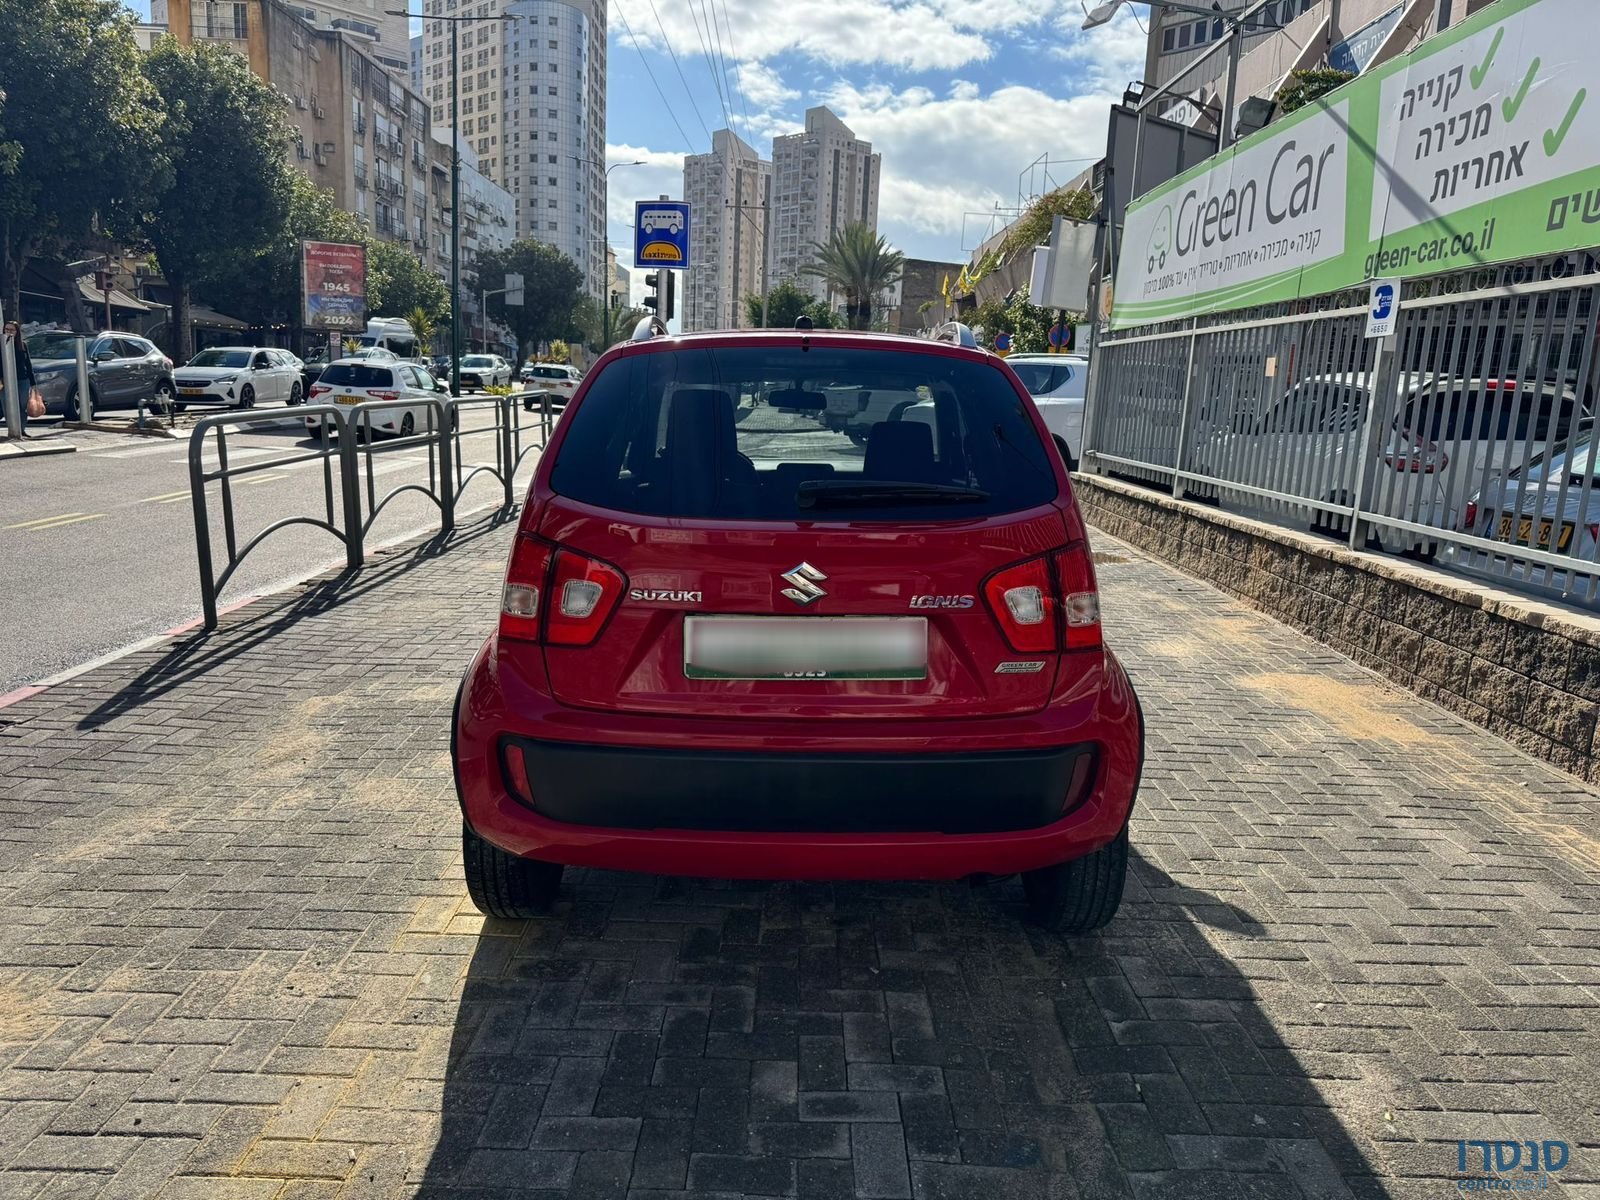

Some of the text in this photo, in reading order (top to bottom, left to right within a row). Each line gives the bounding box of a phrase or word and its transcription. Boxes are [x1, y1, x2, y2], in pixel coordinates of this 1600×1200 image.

[1400, 64, 1464, 121] קנייה
[1415, 102, 1492, 160] מכירה
[1429, 140, 1530, 203] אחריות
[1175, 140, 1335, 257] Green Car
[1259, 238, 1288, 263] מכירה
[1296, 228, 1322, 255] קניה
[1364, 217, 1496, 280] green-car.co.il
[1223, 248, 1253, 273] אחריות
[322, 282, 351, 292] 1945
[1158, 274, 1175, 290] 100%
[324, 315, 354, 325] 2024
[630, 589, 702, 602] SUZUKI
[908, 595, 976, 609] IGNIS
